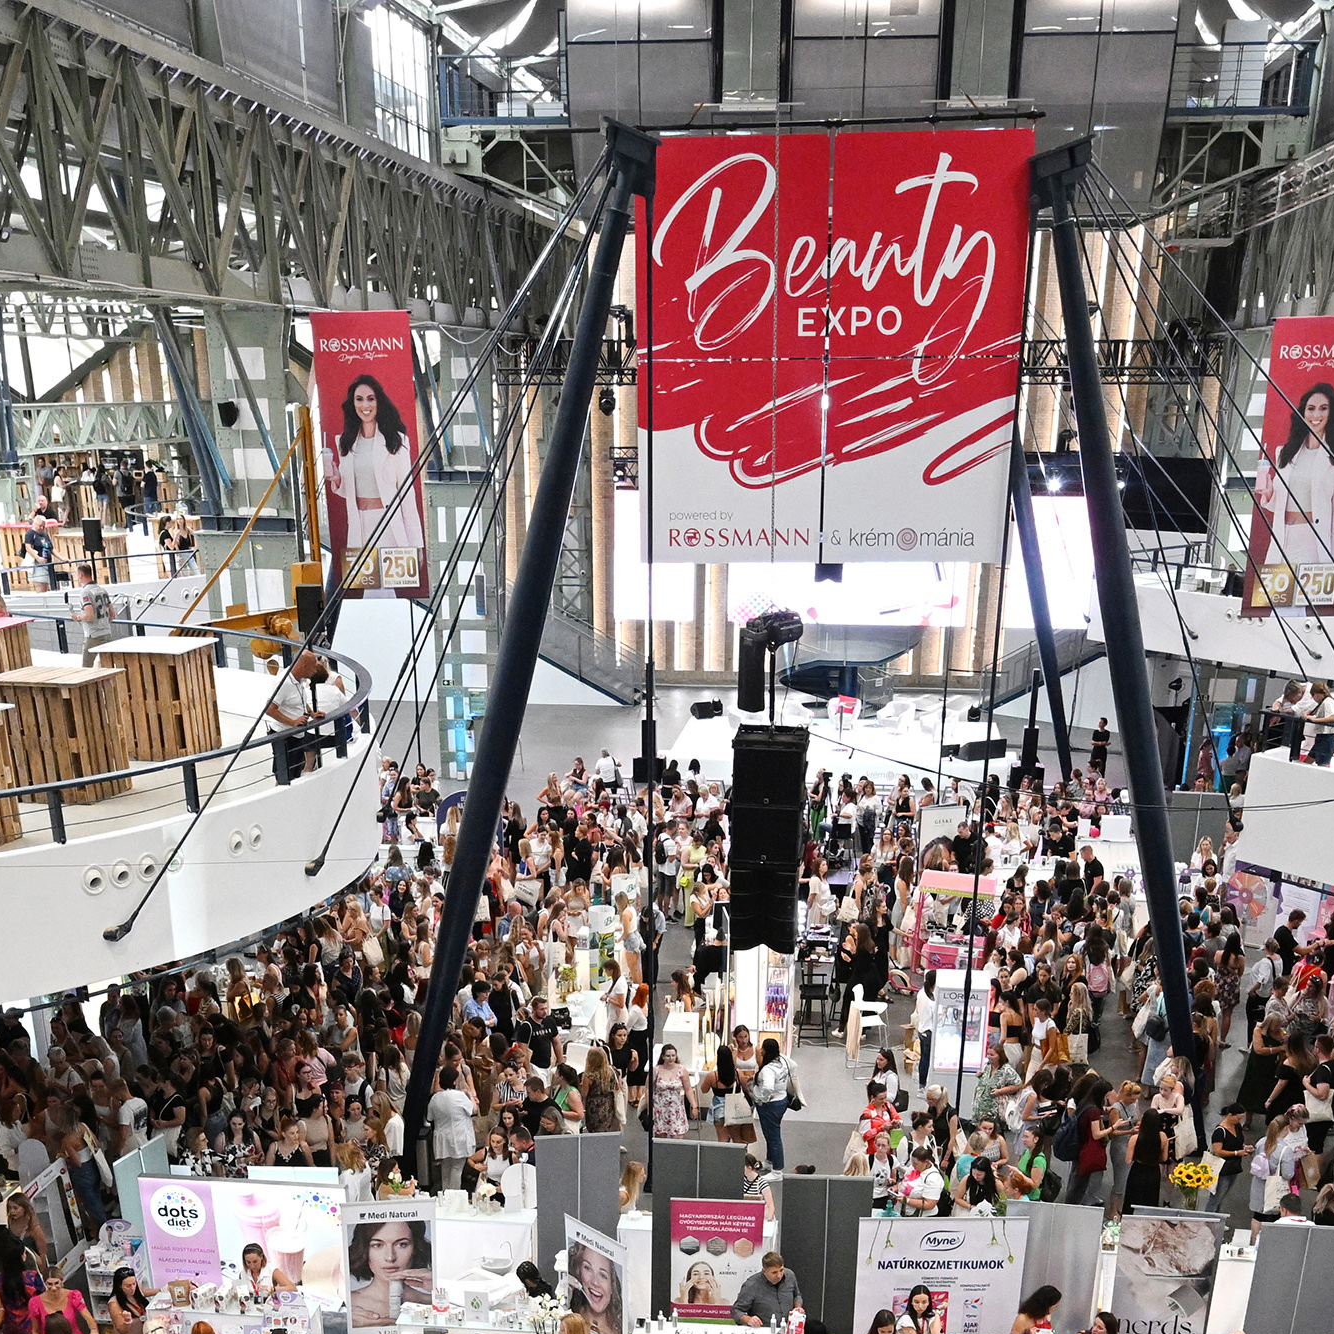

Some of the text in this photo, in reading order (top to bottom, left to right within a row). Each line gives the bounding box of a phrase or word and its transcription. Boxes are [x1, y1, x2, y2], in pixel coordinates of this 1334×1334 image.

[652, 152, 997, 385] Beauty
[797, 306, 902, 336] EXPO
[320, 337, 404, 352] ROSSMANN
[669, 511, 734, 525] powered by
[669, 528, 810, 548] ROSSMANN
[830, 530, 843, 547] &
[383, 556, 417, 578] 250
[943, 992, 982, 1001] L'ORAL
[157, 1204, 199, 1219] dots
[368, 1209, 418, 1220] Medi Natural
[679, 1213, 725, 1222] MAGYARORSZÁG
[167, 1216, 191, 1229] diet
[925, 1236, 959, 1248] Myne
[877, 1257, 1005, 1270] NATÚRKOZMETIKUMOK
